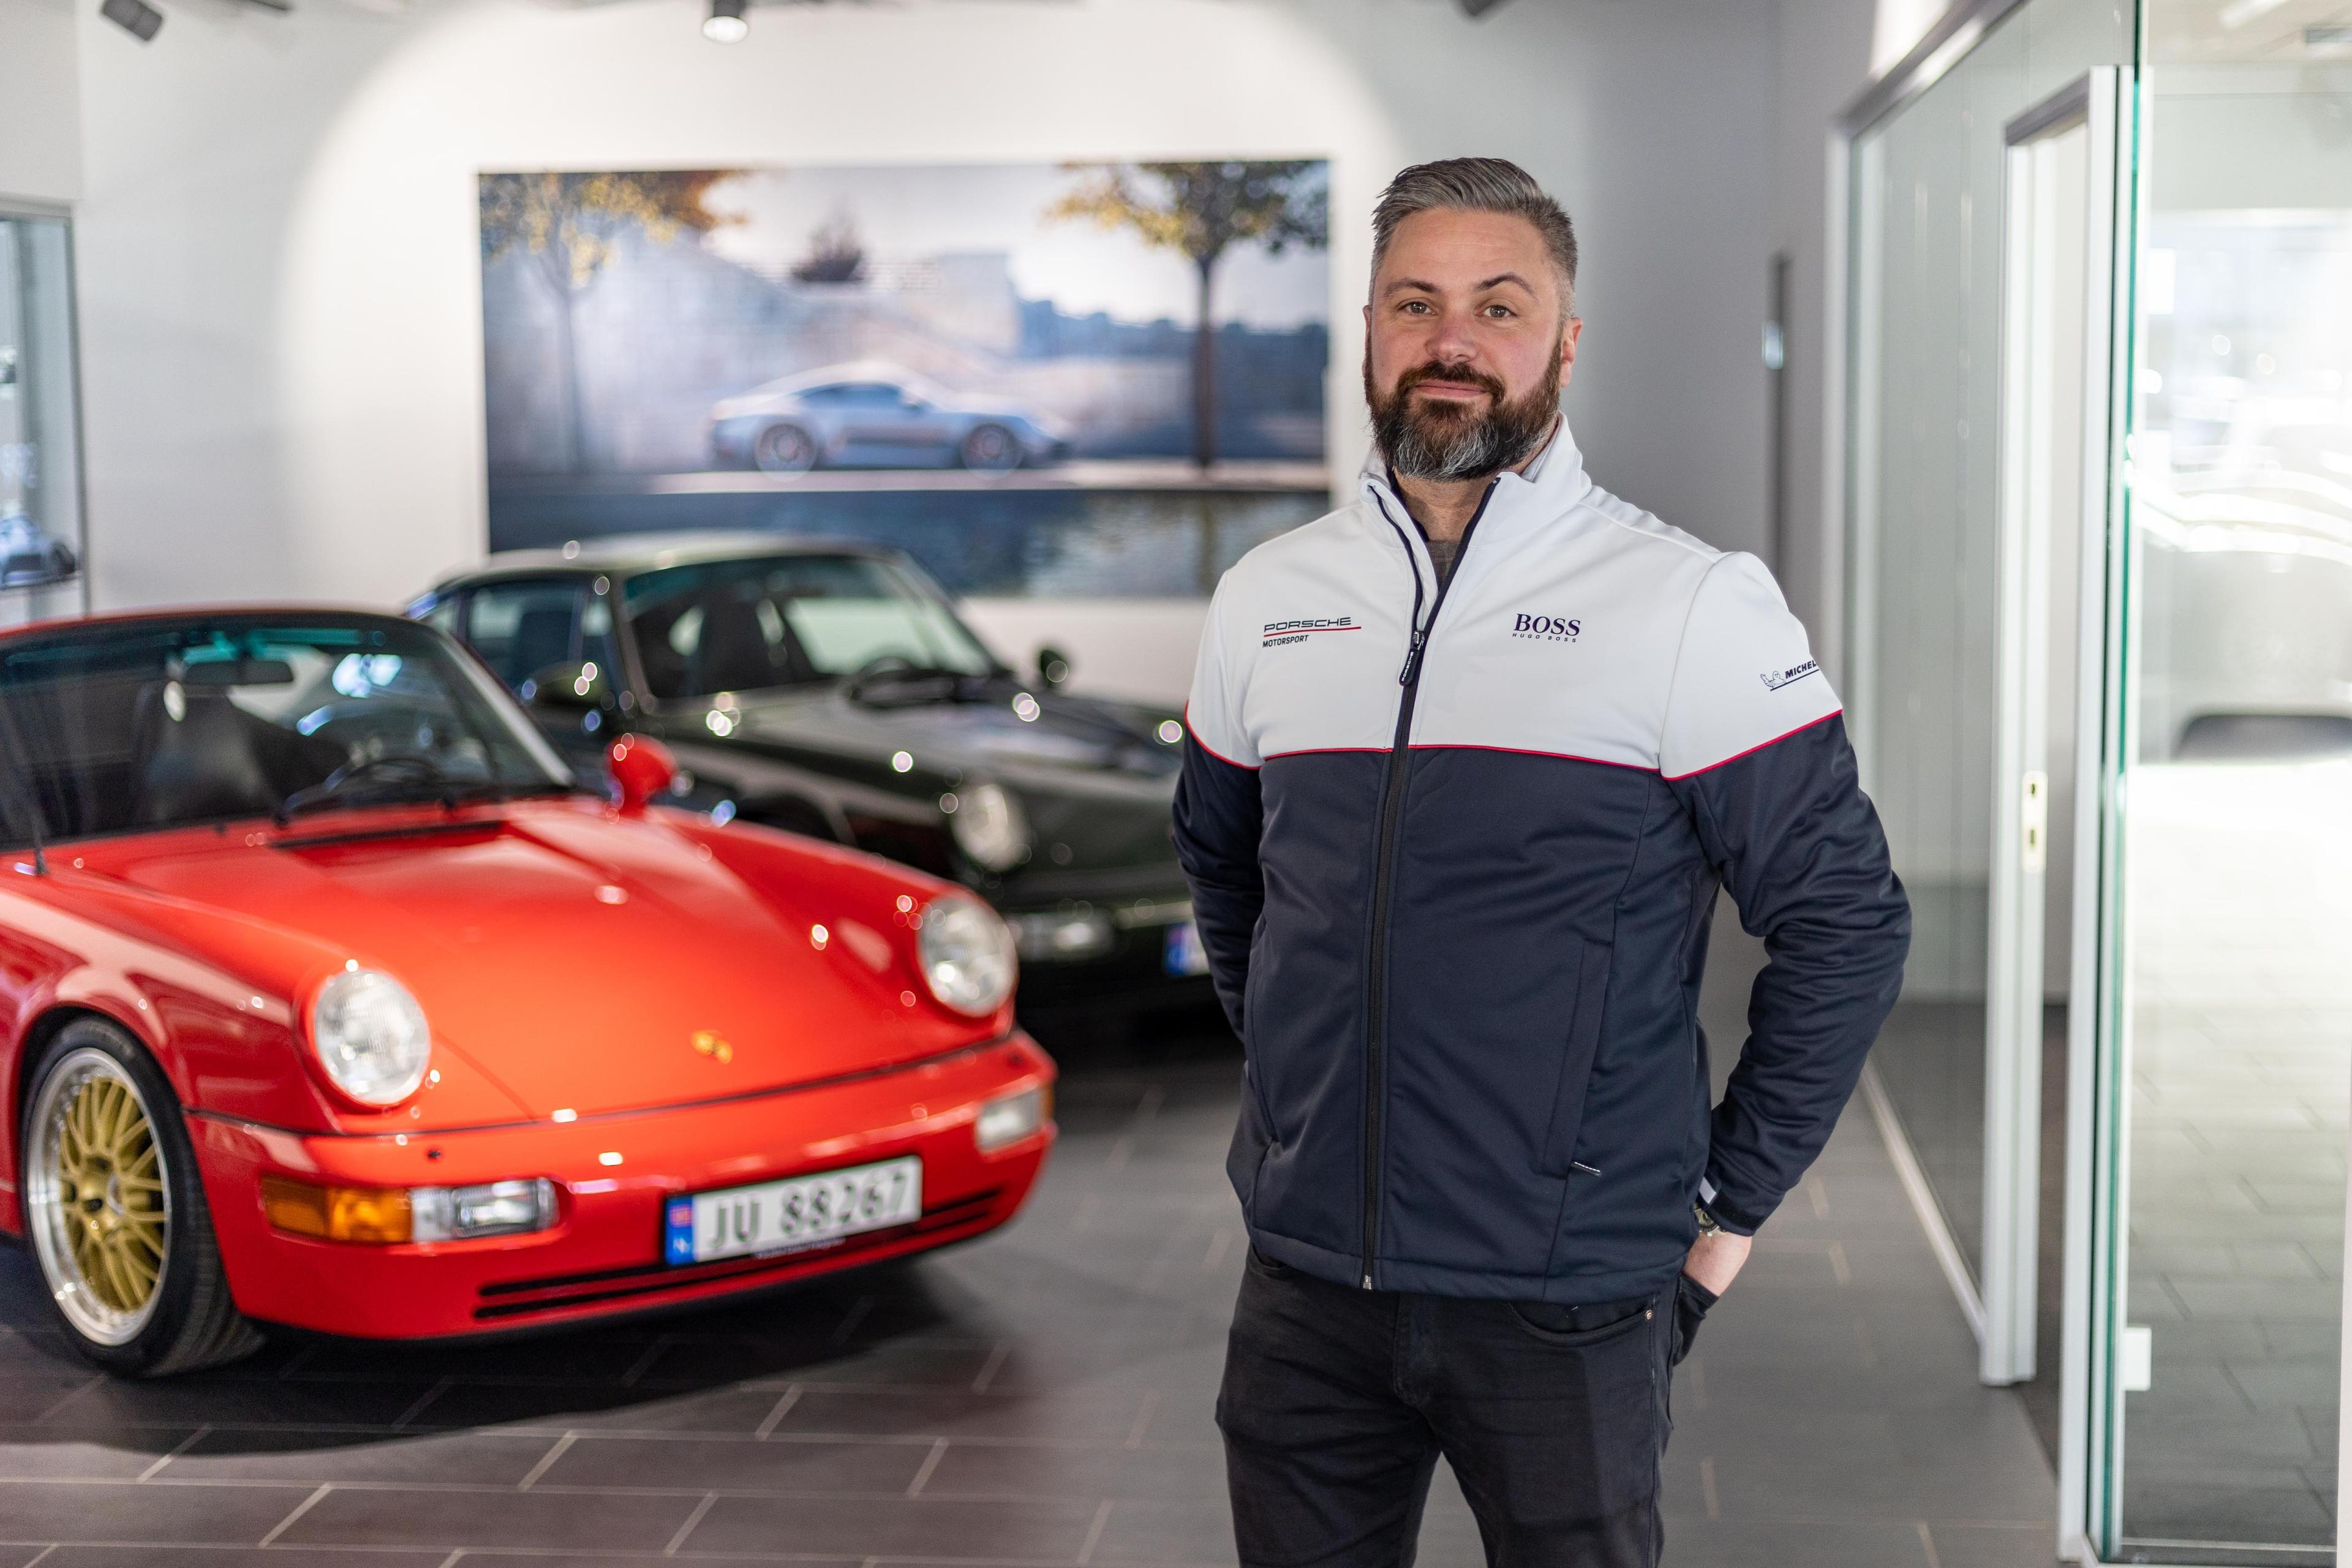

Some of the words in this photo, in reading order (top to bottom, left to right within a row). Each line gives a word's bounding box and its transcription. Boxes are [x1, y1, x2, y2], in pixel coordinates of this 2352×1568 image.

[1264, 617, 1351, 633] PORSCHE
[1513, 613, 1581, 636] BOSS
[1262, 635, 1309, 648] MOTORSPORT
[709, 1197, 763, 1250] JU
[780, 1165, 910, 1238] 88267
